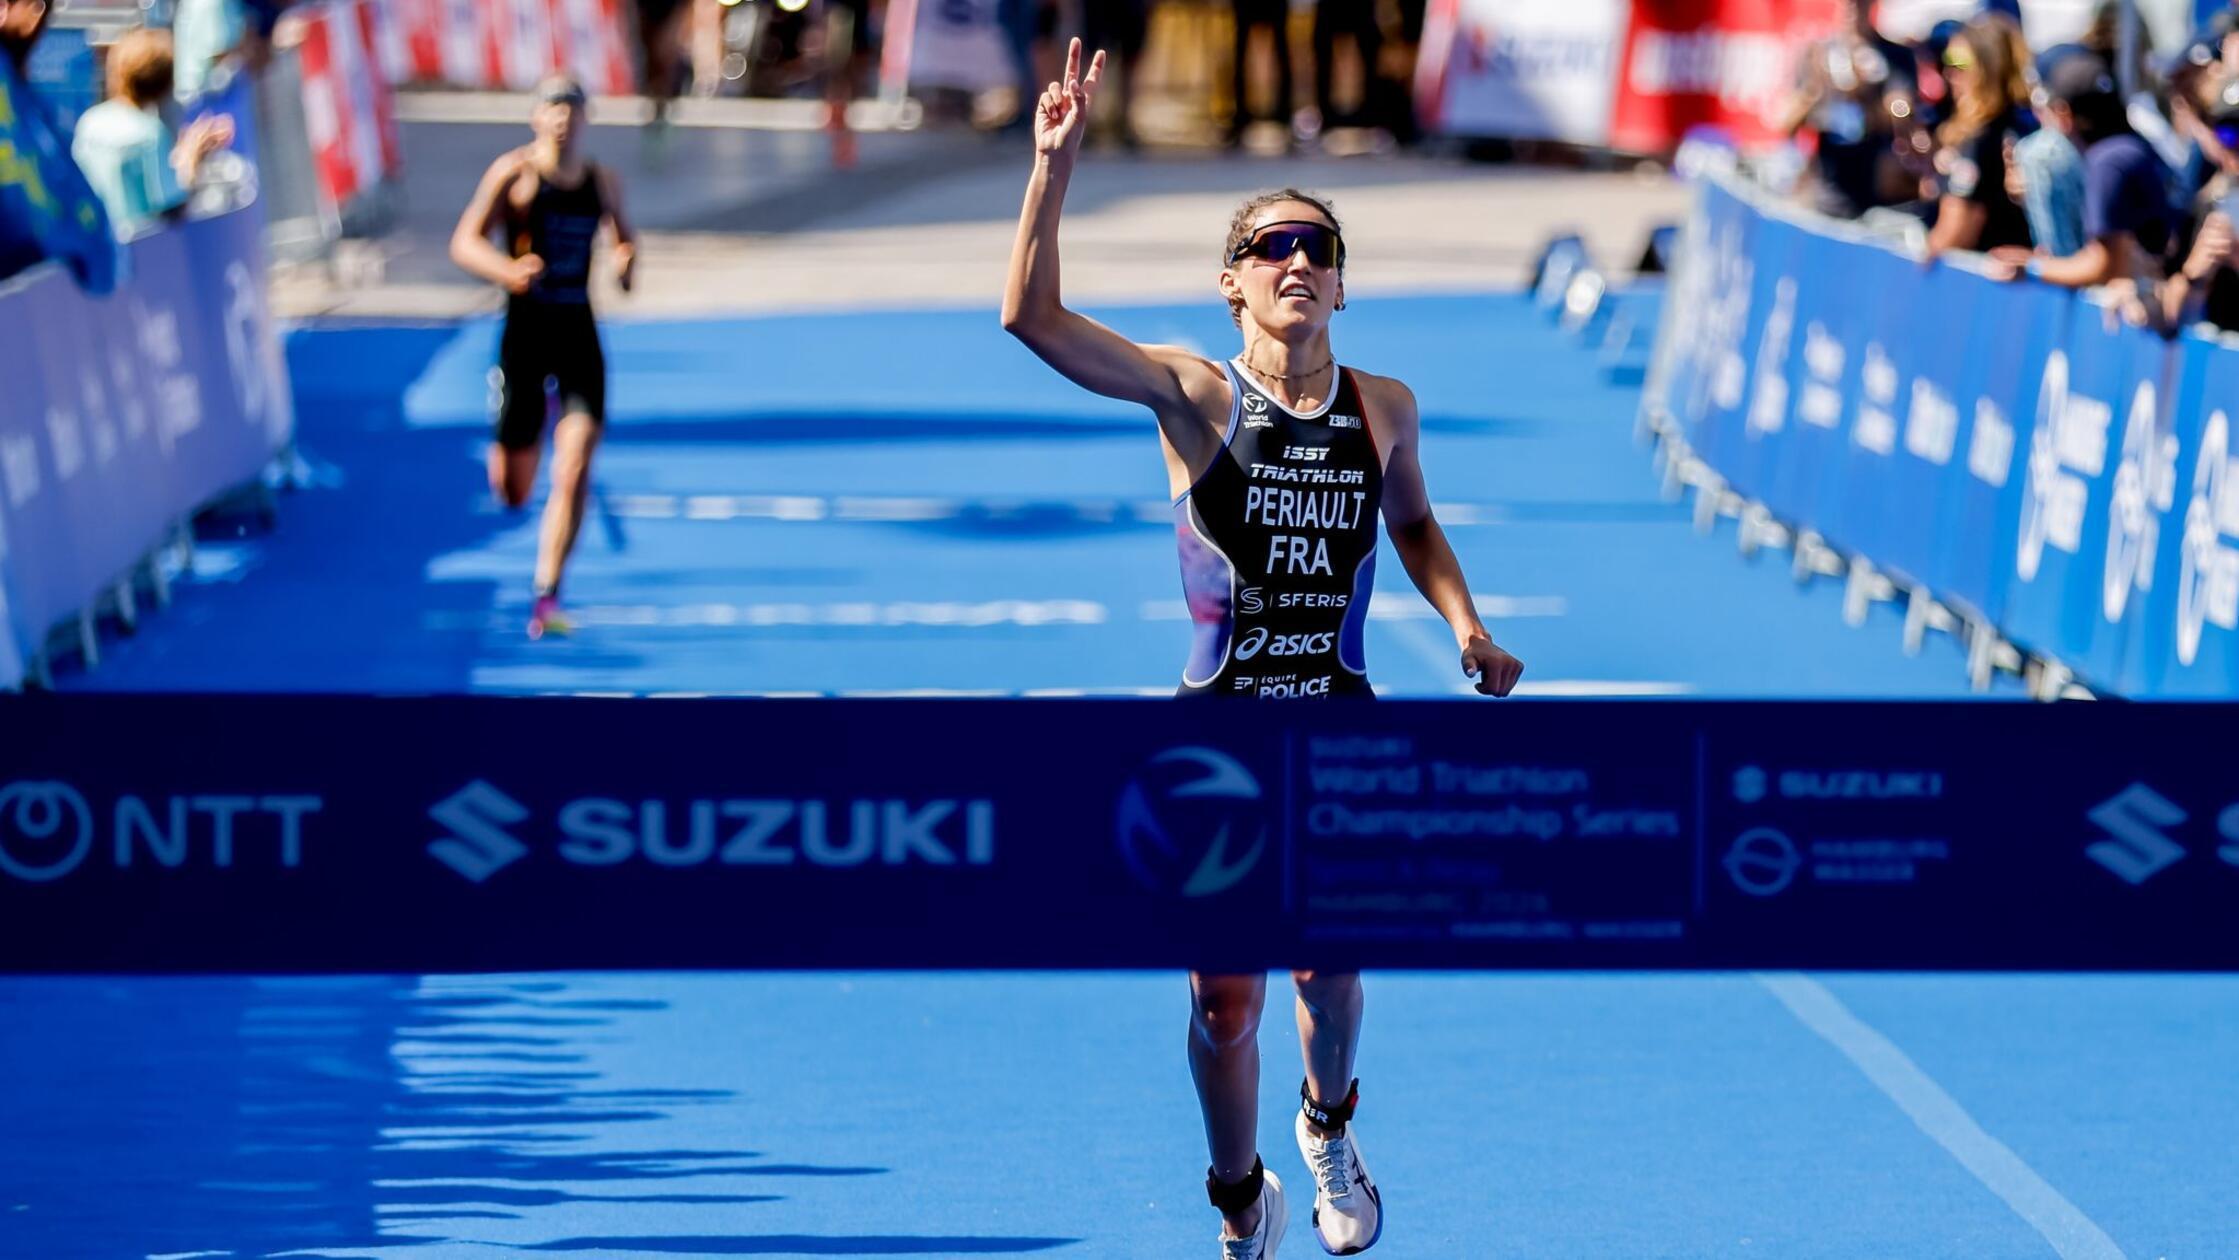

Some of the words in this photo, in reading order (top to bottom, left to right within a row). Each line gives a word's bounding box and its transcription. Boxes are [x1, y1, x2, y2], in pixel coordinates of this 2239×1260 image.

[1244, 486, 1366, 530] PERIAULT
[1266, 535, 1333, 576] FRA
[1260, 675, 1332, 700] POLICE
[1310, 766, 1419, 794] World
[1431, 761, 1588, 794] Triathlon
[1779, 771, 1942, 797] SUZUKI
[114, 795, 323, 868] NTT
[558, 797, 995, 866] SUZUKI
[1308, 803, 1563, 839] Championship
[1572, 803, 1680, 836] Series
